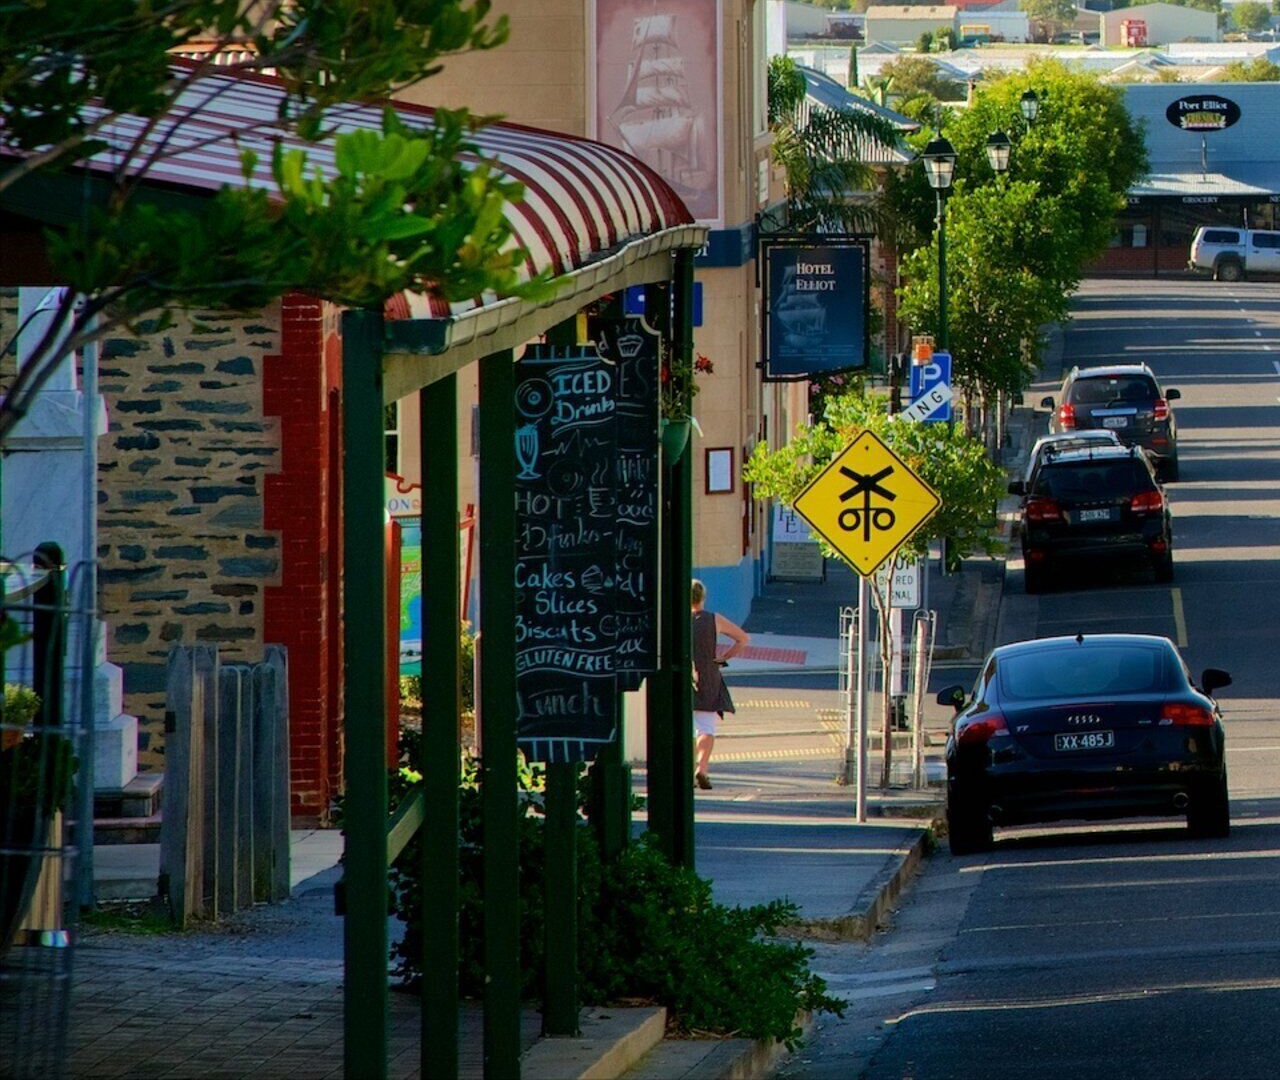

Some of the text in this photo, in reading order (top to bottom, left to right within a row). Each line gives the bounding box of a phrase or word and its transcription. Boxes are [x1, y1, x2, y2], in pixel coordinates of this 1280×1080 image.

[1179, 100, 1228, 110] Port Elliot
[1182, 196, 1219, 204] GROCERY
[796, 262, 835, 275] HOTEL
[796, 279, 836, 291] ELLIOT
[552, 370, 611, 396] ICED
[551, 396, 616, 425] Drinks
[514, 491, 571, 519] HOT
[514, 563, 576, 589] Cakes
[895, 575, 913, 585] RED
[534, 590, 598, 615] Slices
[515, 650, 575, 670] GLUTEN
[576, 654, 614, 671] FREE
[515, 681, 604, 721] Lunch
